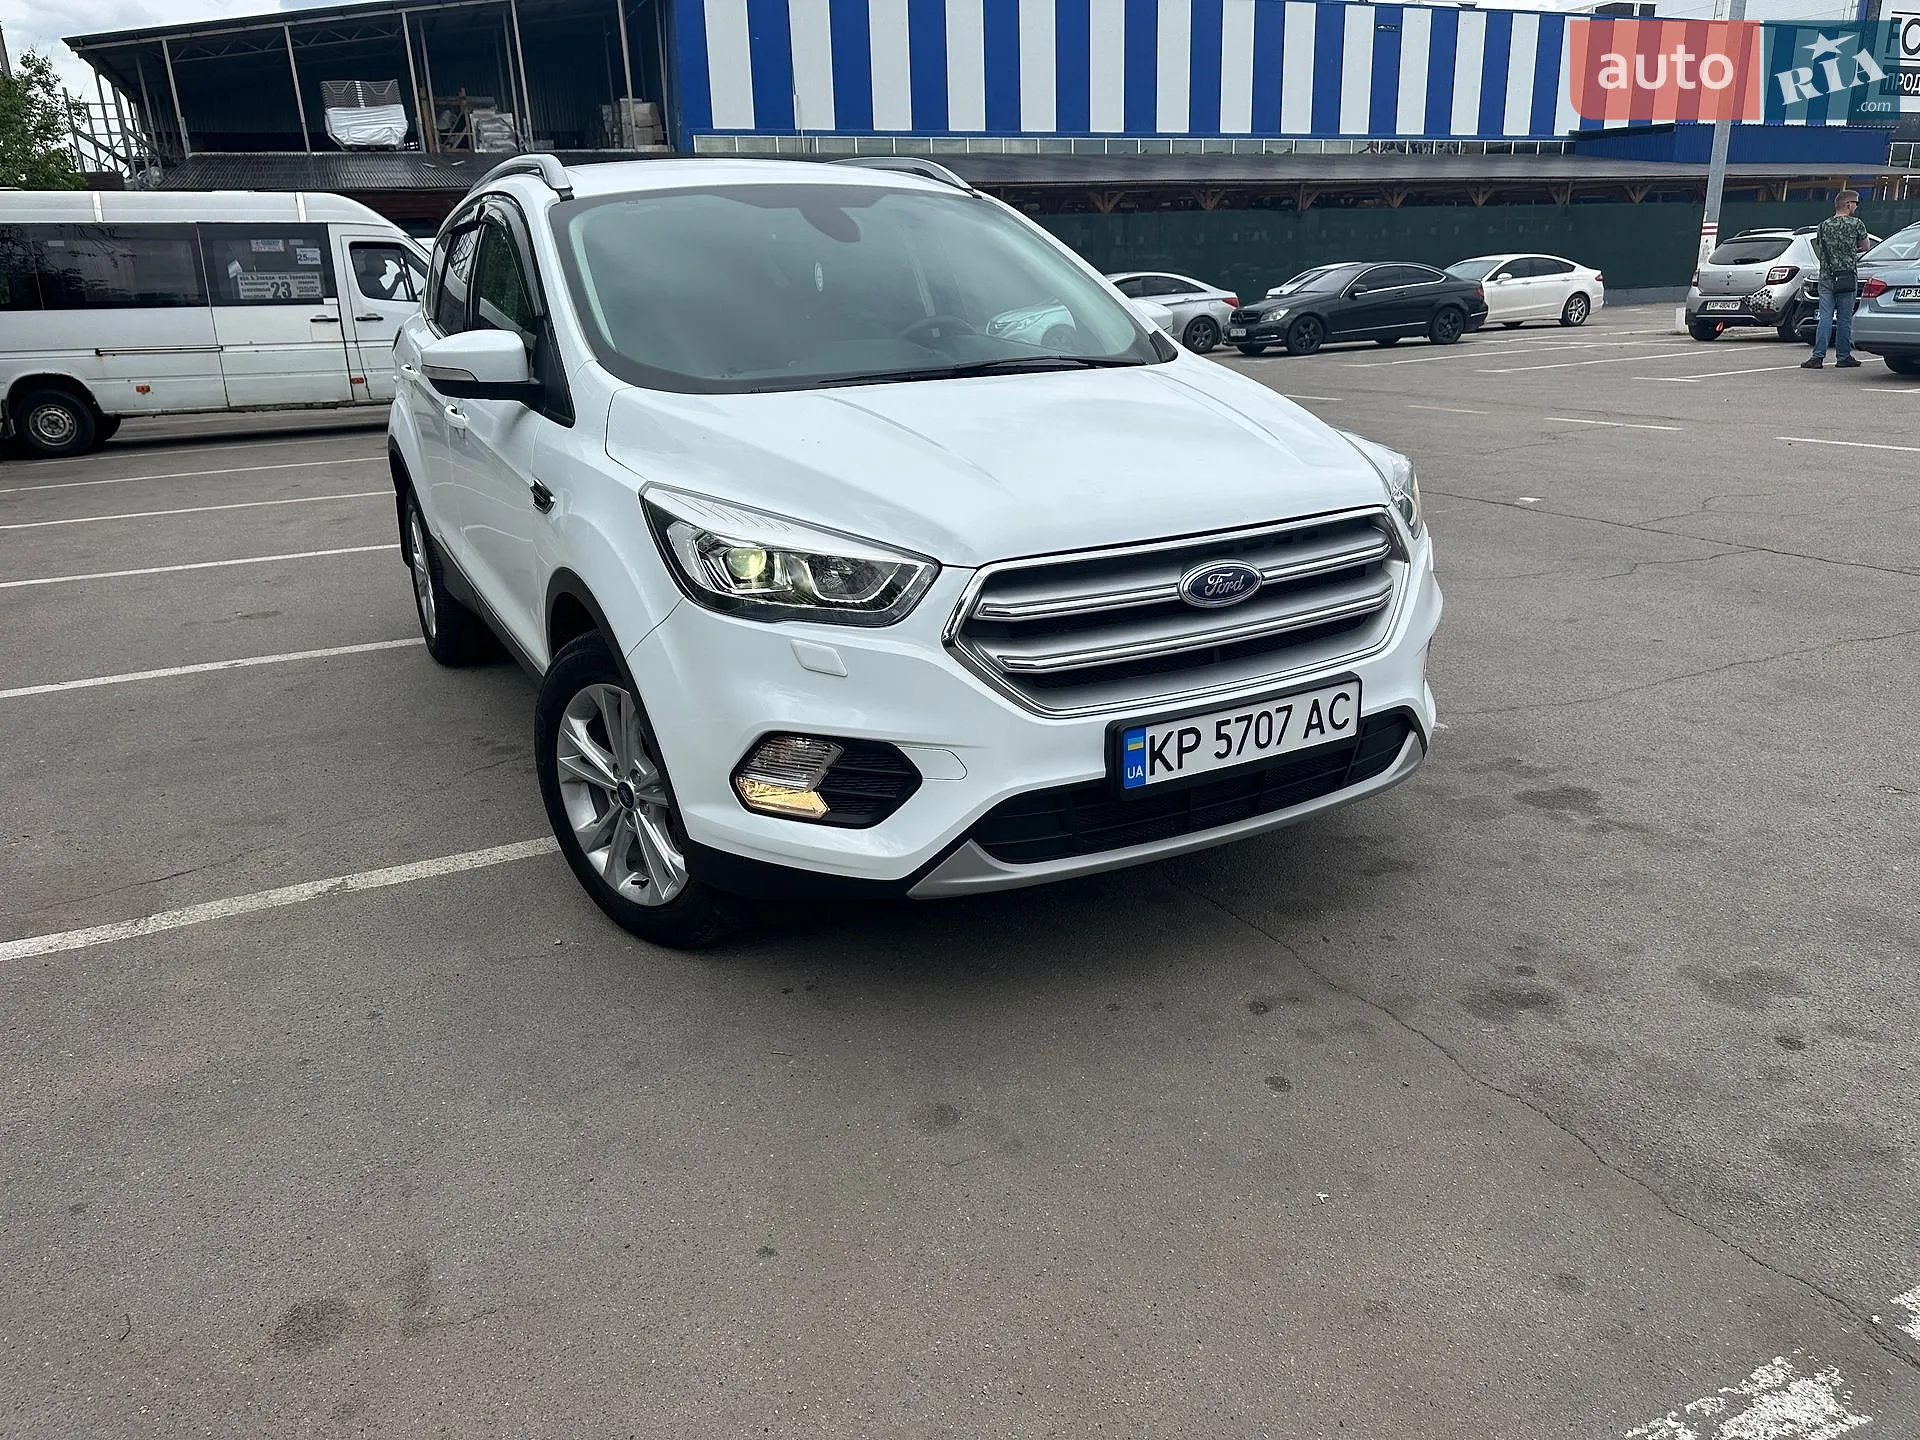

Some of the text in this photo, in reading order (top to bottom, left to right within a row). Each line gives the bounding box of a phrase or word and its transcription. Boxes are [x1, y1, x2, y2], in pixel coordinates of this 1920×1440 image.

[270, 281, 292, 299] 23
[1204, 572, 1245, 597] Ford
[1149, 692, 1351, 776] KP 5707 AC
[1127, 765, 1144, 779] UA
